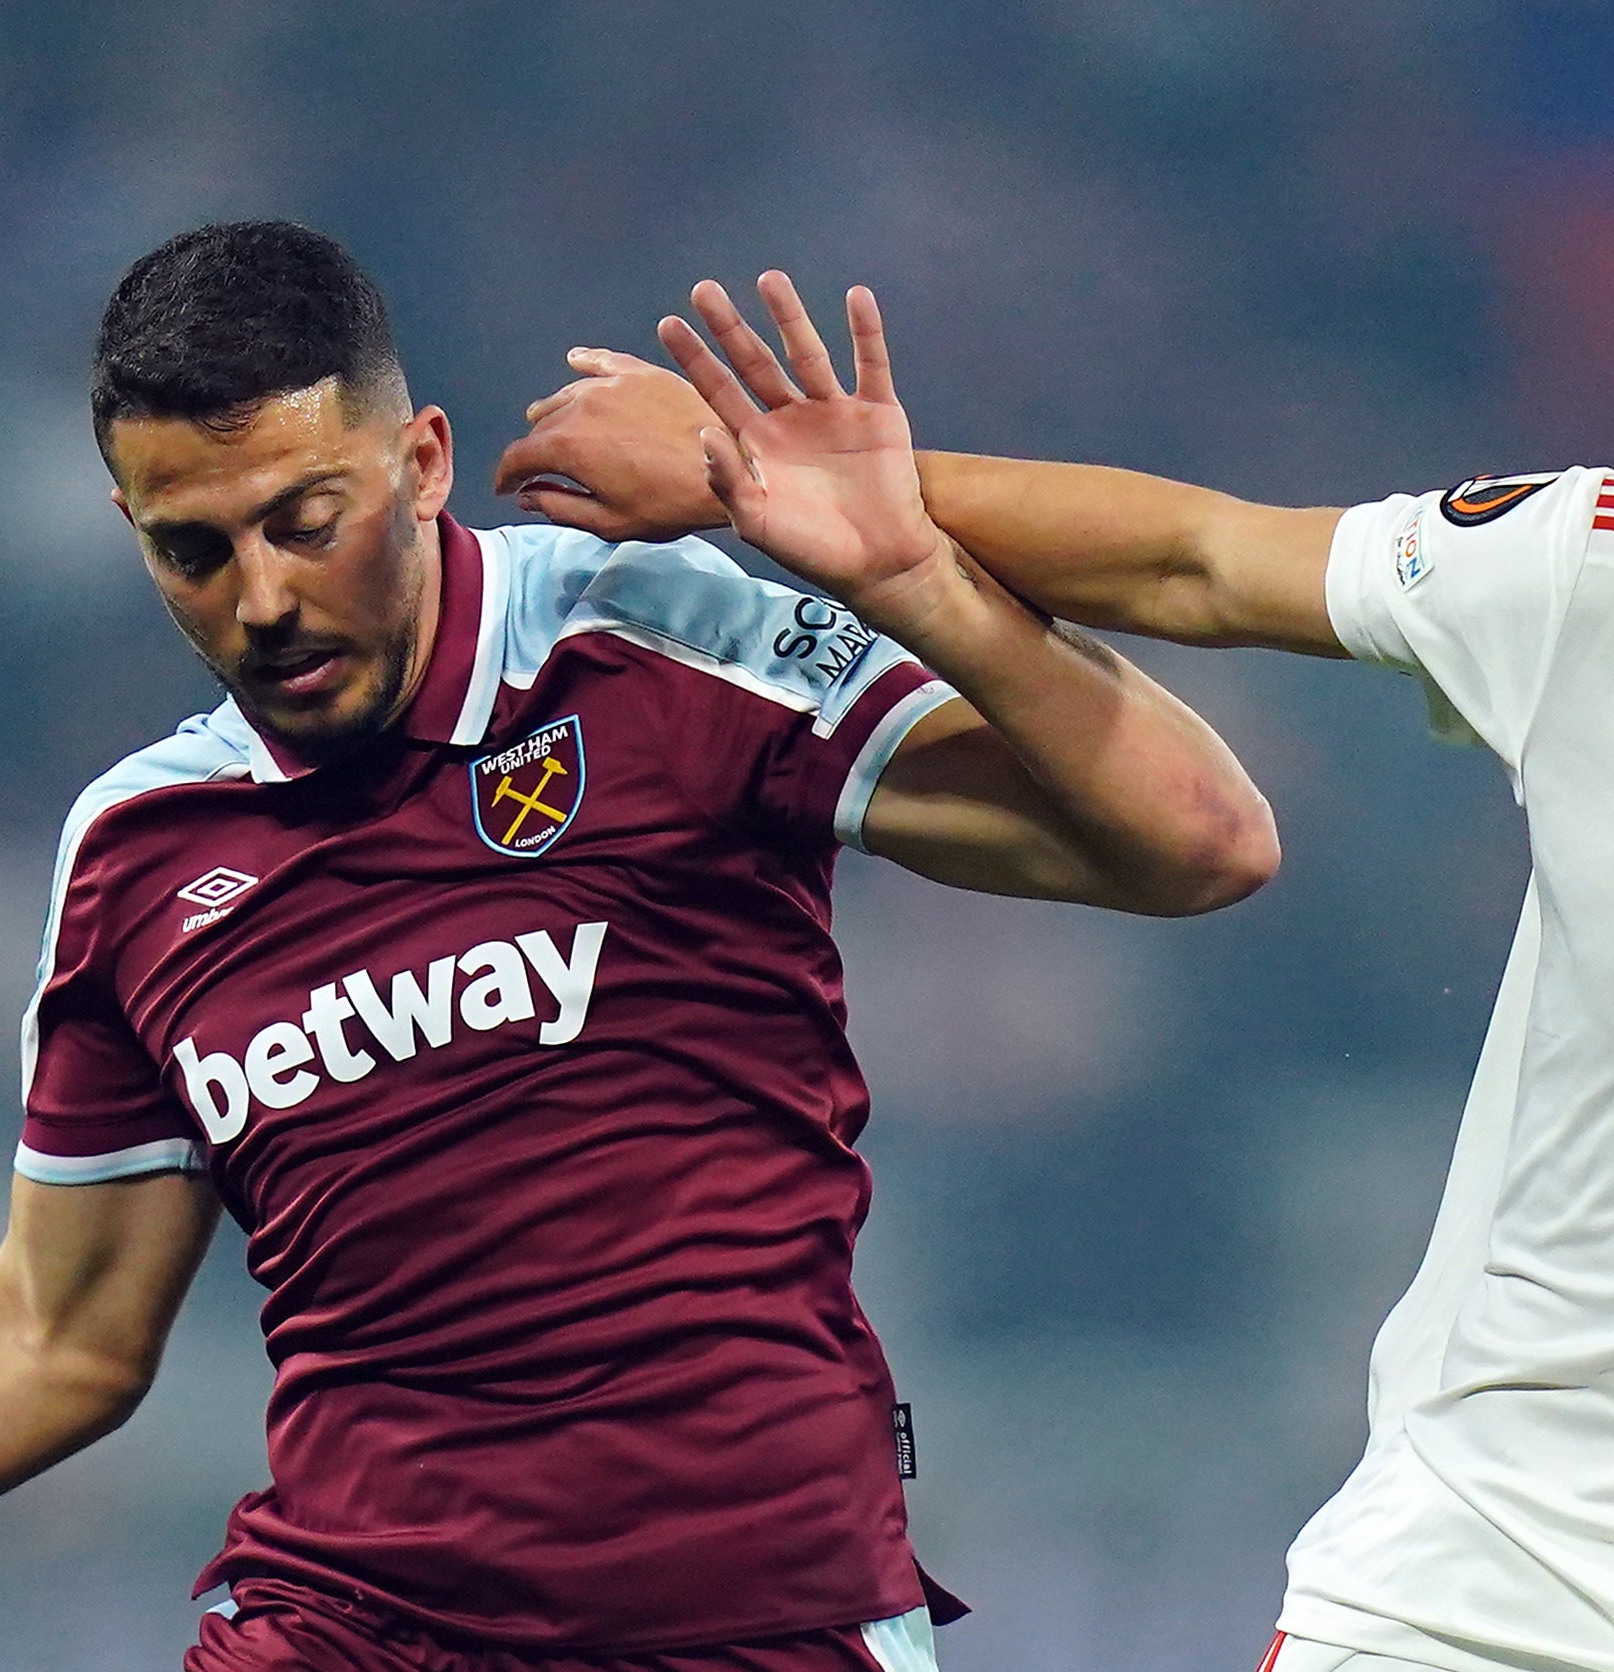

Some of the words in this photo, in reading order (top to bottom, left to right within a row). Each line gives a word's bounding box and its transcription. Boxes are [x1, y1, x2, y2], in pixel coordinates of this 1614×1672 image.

[773, 597, 846, 660] SC
[481, 742, 526, 775] WEST
[527, 725, 569, 753] HAM
[500, 745, 551, 775] UNITED
[514, 825, 556, 848] LONDON
[172, 921, 608, 1145] betway
